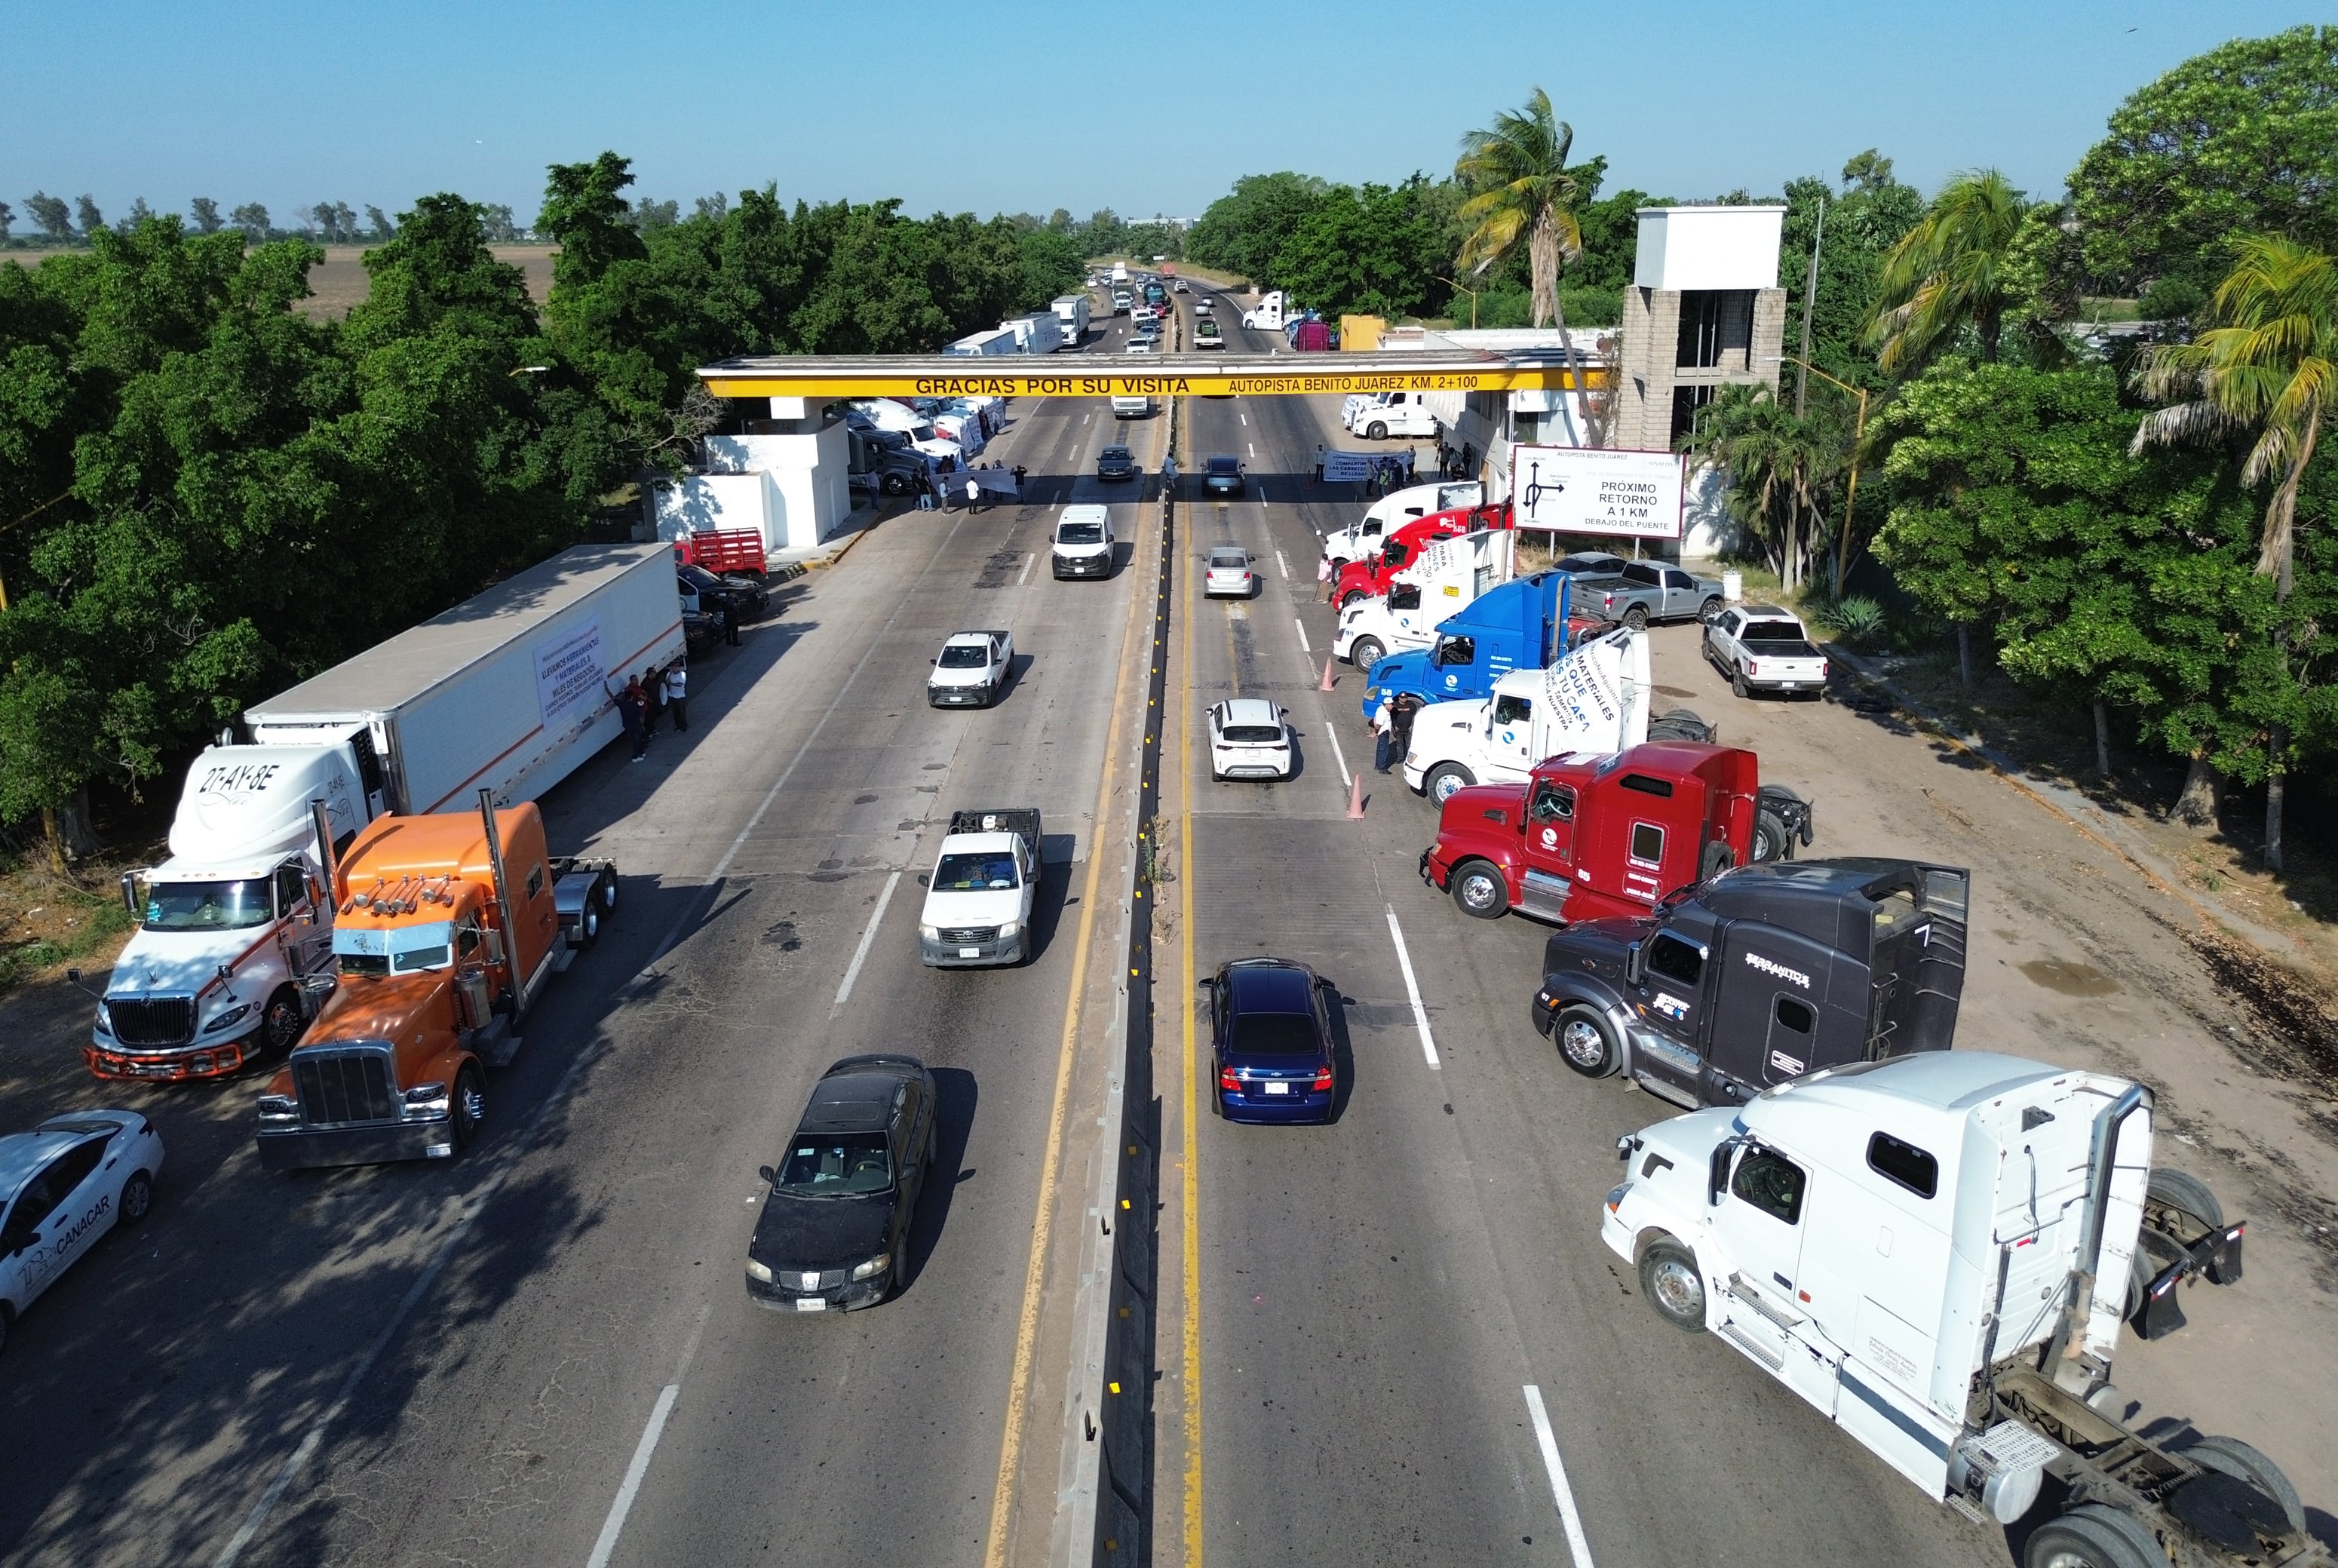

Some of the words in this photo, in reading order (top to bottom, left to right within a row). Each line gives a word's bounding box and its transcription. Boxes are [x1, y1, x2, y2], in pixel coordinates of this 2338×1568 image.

[916, 378, 1016, 394] GRACIAS
[1026, 378, 1072, 394] POR
[1082, 378, 1112, 394] SU
[1121, 378, 1190, 394] VISITA
[1229, 378, 1300, 392] AUTOPISTA
[1304, 377, 1351, 391] BENITO
[1355, 376, 1404, 390] JUAREZ
[1411, 376, 1434, 389] KM.
[1438, 376, 1477, 388] 2+100
[1601, 480, 1656, 493] PRÓXIMO
[1600, 493, 1657, 505] RETORNO
[1607, 506, 1615, 516] A
[1620, 507, 1625, 517] 1
[1630, 508, 1648, 517] KM
[1585, 517, 1618, 526] DEBAJO
[1637, 521, 1669, 530] PUENTE
[542, 658, 566, 680] LLEVAMOS
[559, 657, 588, 680] MATERIALES
[573, 663, 596, 687] NEGOCIOS
[1569, 669, 1588, 698] QUE
[1576, 655, 1615, 721] MATERIALES
[1548, 695, 1569, 731] NUESTRA
[1559, 675, 1571, 693] TU
[1566, 696, 1590, 732] CASA
[199, 764, 281, 793] 27-AY-8E
[1578, 868, 1591, 882] 85
[1541, 992, 1550, 1002] 07
[57, 1195, 110, 1255] CANACAR
